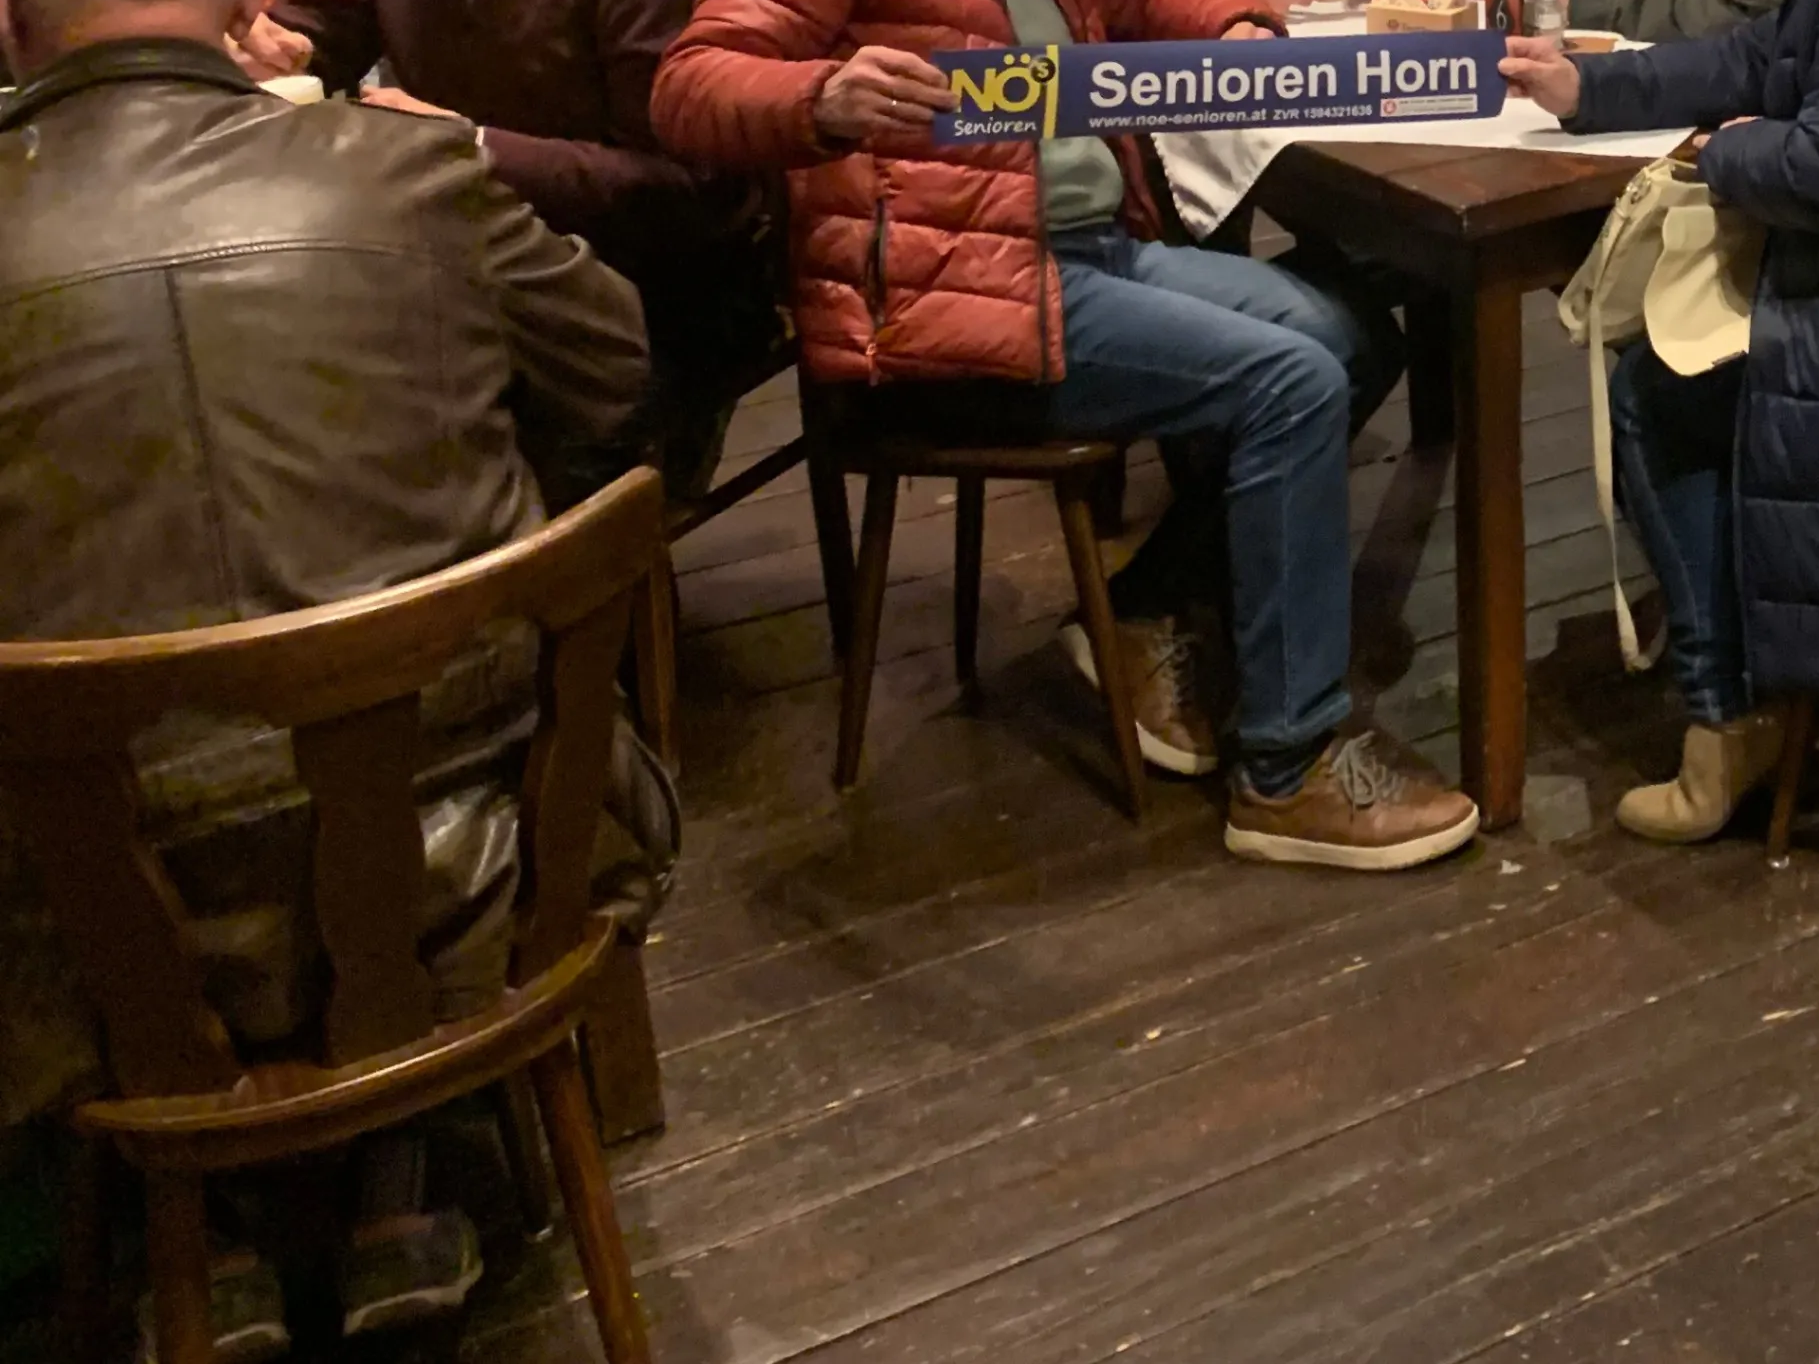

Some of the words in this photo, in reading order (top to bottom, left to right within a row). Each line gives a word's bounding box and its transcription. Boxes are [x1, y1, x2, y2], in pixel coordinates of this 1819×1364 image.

[1089, 58, 1337, 108] Senioren
[1356, 50, 1478, 95] Horn
[954, 117, 1037, 137] Senioren
[1089, 108, 1267, 129] www.noe-senioren.at
[1273, 109, 1300, 121] ZVR
